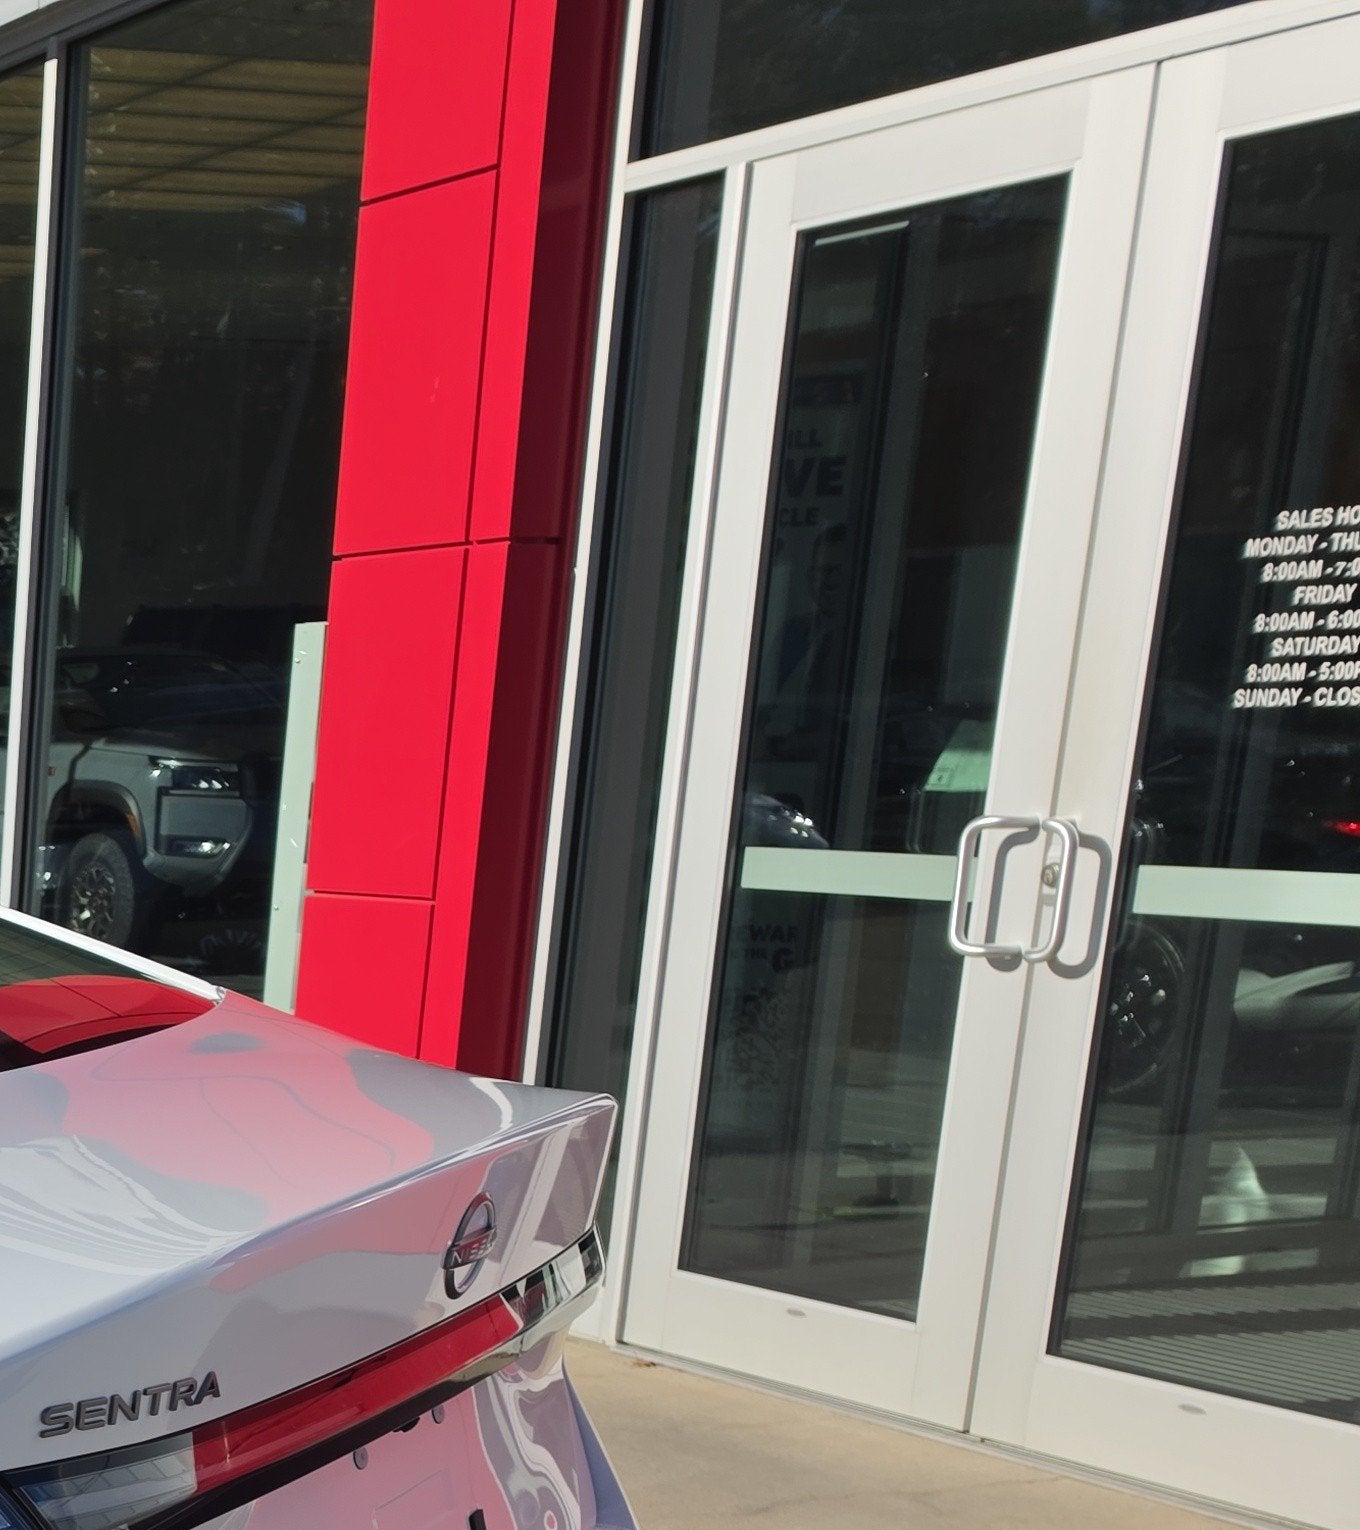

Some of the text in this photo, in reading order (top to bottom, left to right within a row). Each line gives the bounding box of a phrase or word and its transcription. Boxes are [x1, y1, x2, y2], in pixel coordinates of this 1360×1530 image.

[1277, 507, 1334, 531] SALES
[1243, 534, 1319, 558] MONDAY
[1262, 560, 1323, 582] 8:00AM
[1293, 583, 1358, 605] FRIDAY
[1254, 611, 1315, 632] 8:00AM
[1327, 609, 1360, 629] 6:00
[1270, 635, 1360, 657] SATURDAY
[1246, 661, 1307, 682] 8:00AM
[1233, 687, 1303, 708] SUNDAY
[1314, 686, 1360, 707] CLOS
[39, 1371, 221, 1438] SENTRA
